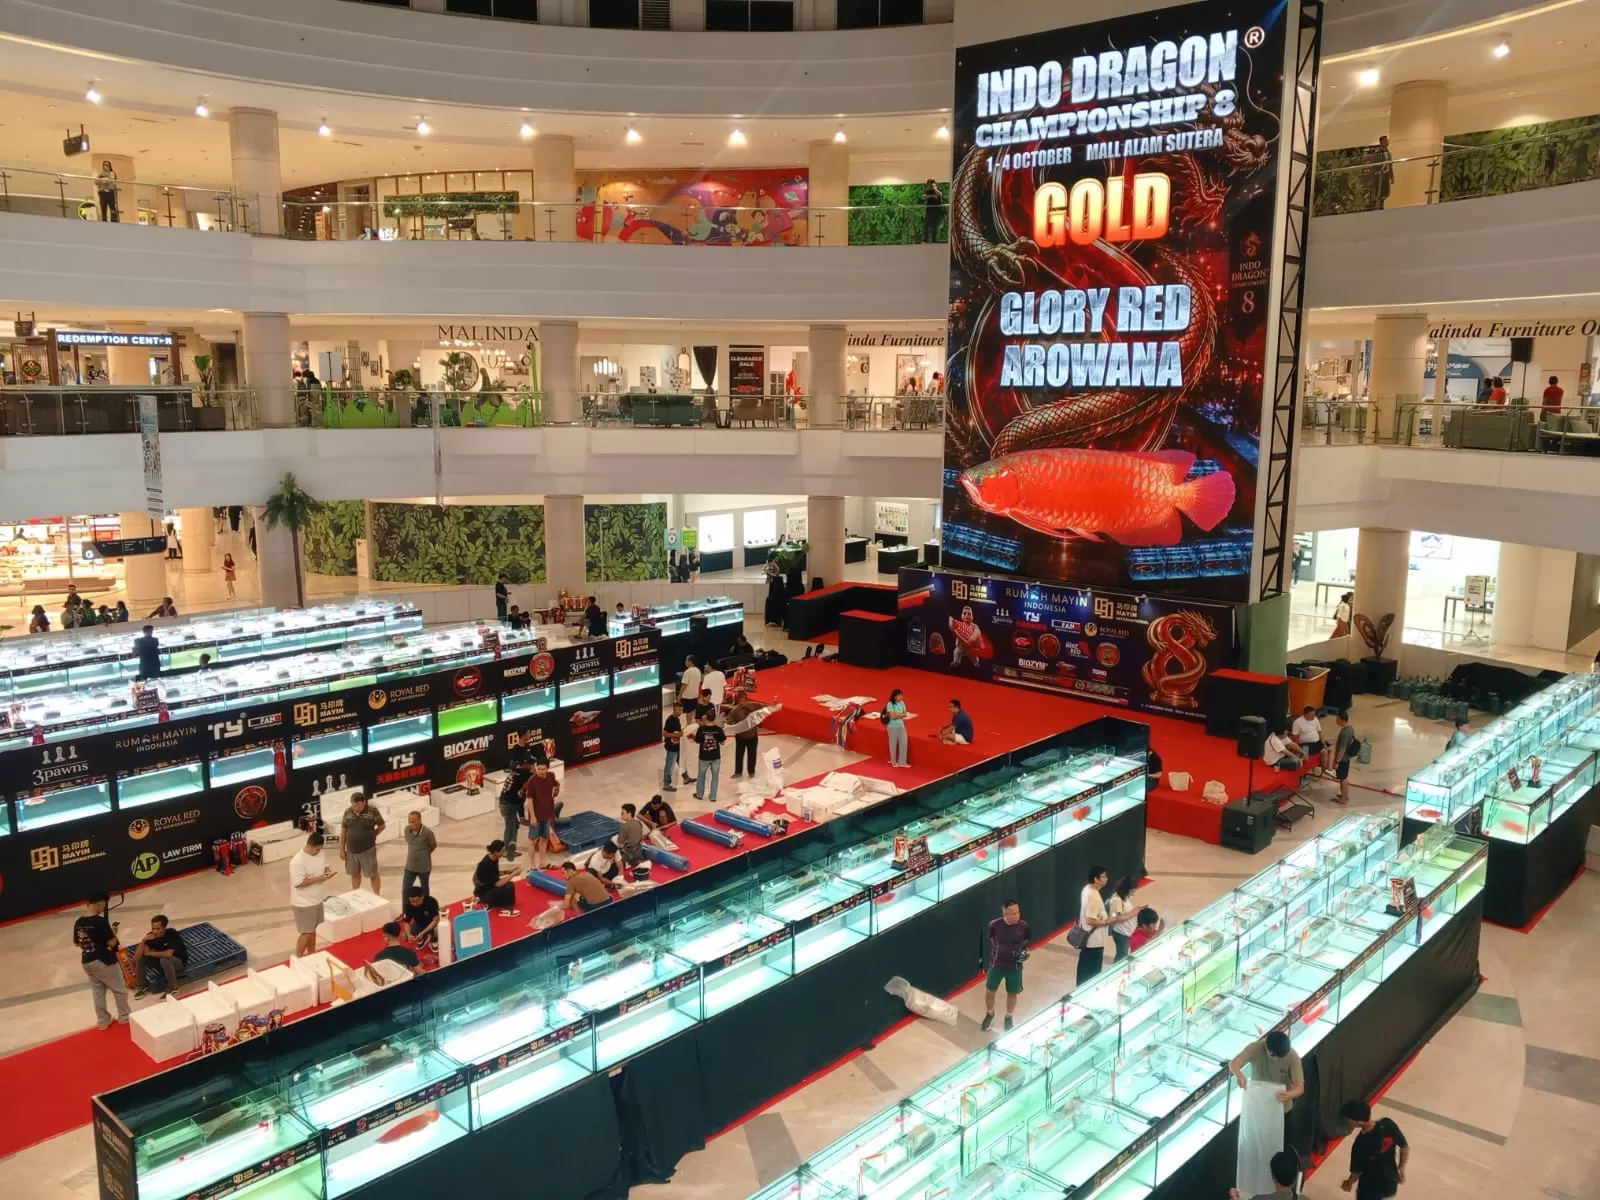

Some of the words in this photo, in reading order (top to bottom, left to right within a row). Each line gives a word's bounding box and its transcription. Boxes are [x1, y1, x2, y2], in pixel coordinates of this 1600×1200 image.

[977, 60, 1063, 118] INDO
[1071, 29, 1239, 103] DRAGON
[975, 93, 1207, 148] CHAMPIONSHIP
[1213, 89, 1236, 117] 8
[1013, 147, 1072, 168] OCTOBER
[1086, 140, 1122, 161] MALL
[1123, 137, 1163, 158] ALAM
[1166, 127, 1224, 153] SUTERA
[1033, 172, 1171, 249] GOLD
[999, 287, 1111, 336] GLORY
[1117, 283, 1191, 333] RED
[1242, 290, 1255, 313] 8
[438, 324, 539, 341] MALINDA
[1428, 323, 1482, 338] alinda
[1488, 320, 1575, 337] Furniture
[57, 334, 128, 345] REDEMPTION
[880, 334, 944, 347] Furniture
[1000, 341, 1183, 387] AROWANA
[1024, 601, 1066, 613] INDONESIA
[1051, 595, 1088, 607] MAYIN
[569, 660, 600, 675] 3pawns
[390, 687, 414, 698] ROYAL
[415, 684, 430, 693] RED
[320, 708, 344, 718] MAYIN
[320, 713, 357, 723] INTERNATIONAL
[163, 727, 198, 741] MAYIN
[136, 740, 178, 753] INDONESIA
[444, 735, 490, 758] BIOZYM
[32, 763, 89, 786] 3pawns
[154, 813, 181, 827] ROYAL
[183, 809, 201, 819] RED
[62, 840, 89, 853] 马印牌
[62, 848, 90, 858] MAYIN
[162, 849, 181, 859] LAW
[182, 843, 203, 855] FIRM
[62, 852, 107, 866] INTERNATIONAL
[134, 857, 156, 873] AP
